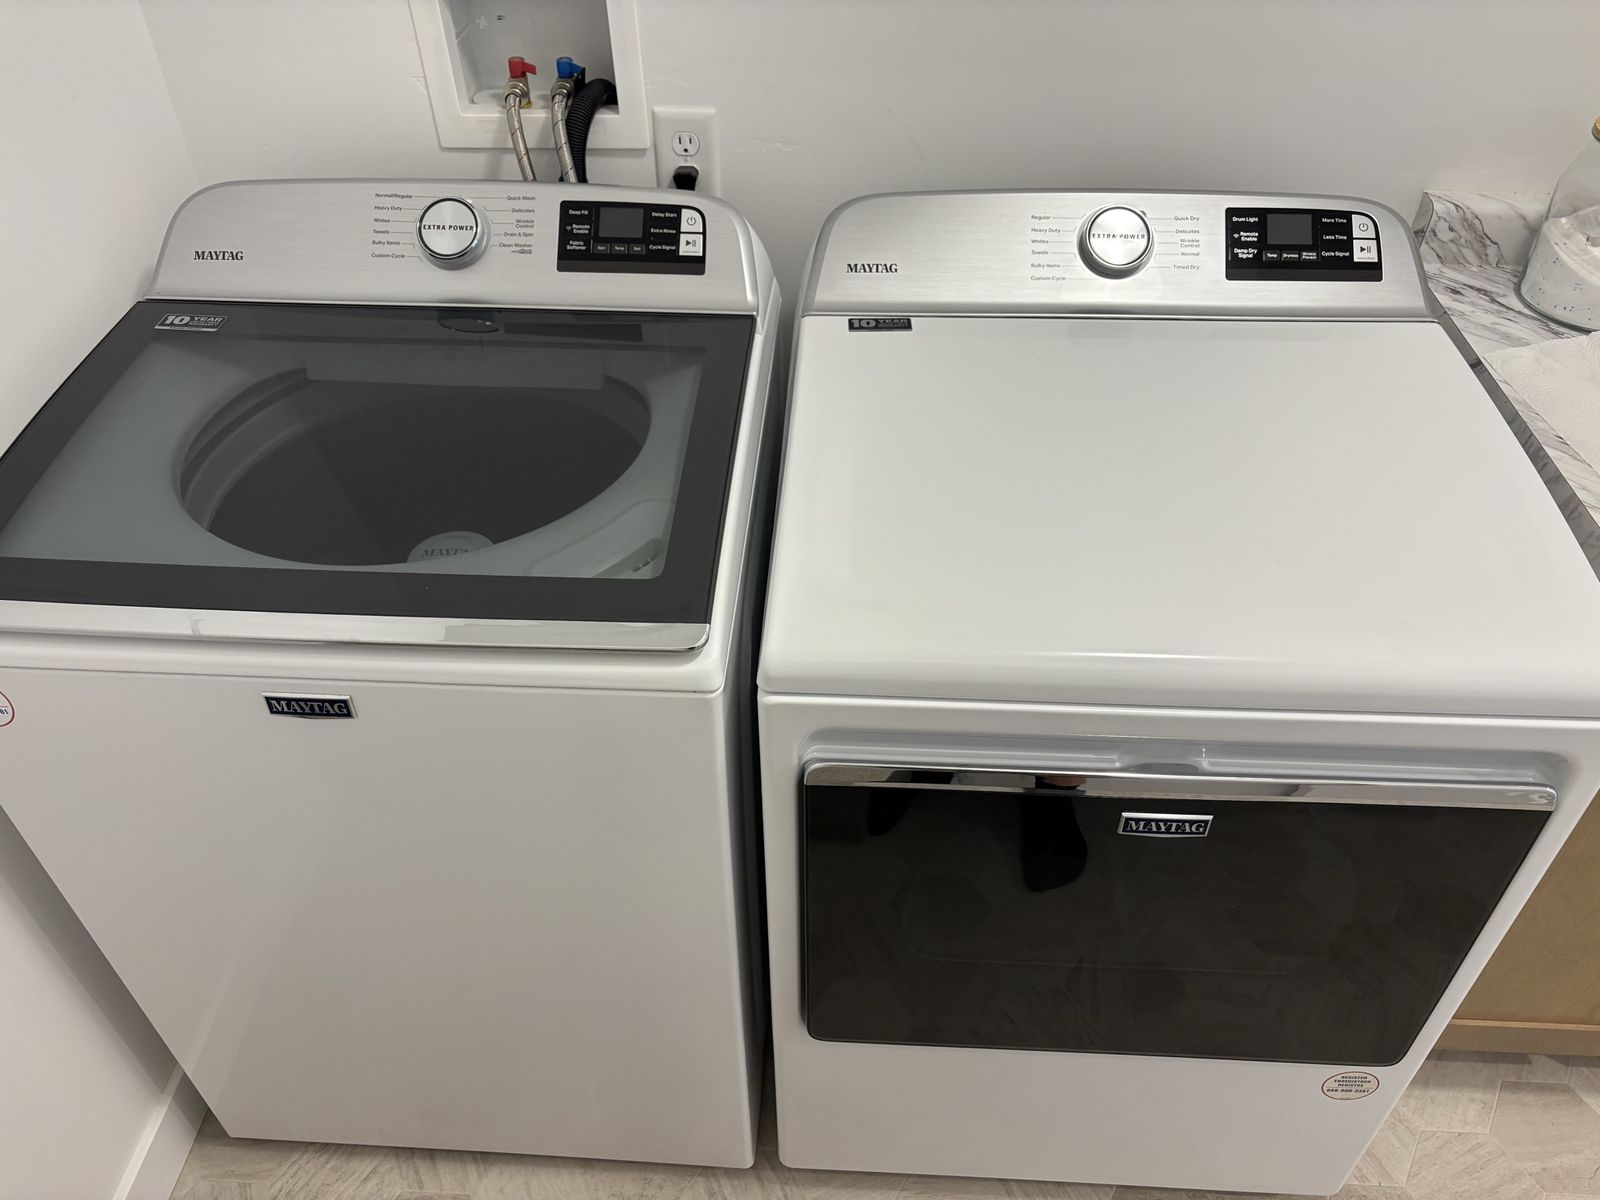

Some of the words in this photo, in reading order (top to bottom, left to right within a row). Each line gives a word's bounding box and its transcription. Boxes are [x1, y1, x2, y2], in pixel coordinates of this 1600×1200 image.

[194, 250, 244, 261] MAYTAG
[846, 264, 898, 273] MAYTAG
[164, 316, 191, 325] 10
[851, 319, 876, 328] 10
[270, 700, 348, 714] MAYTAG
[1127, 820, 1205, 833] MAYTAG
